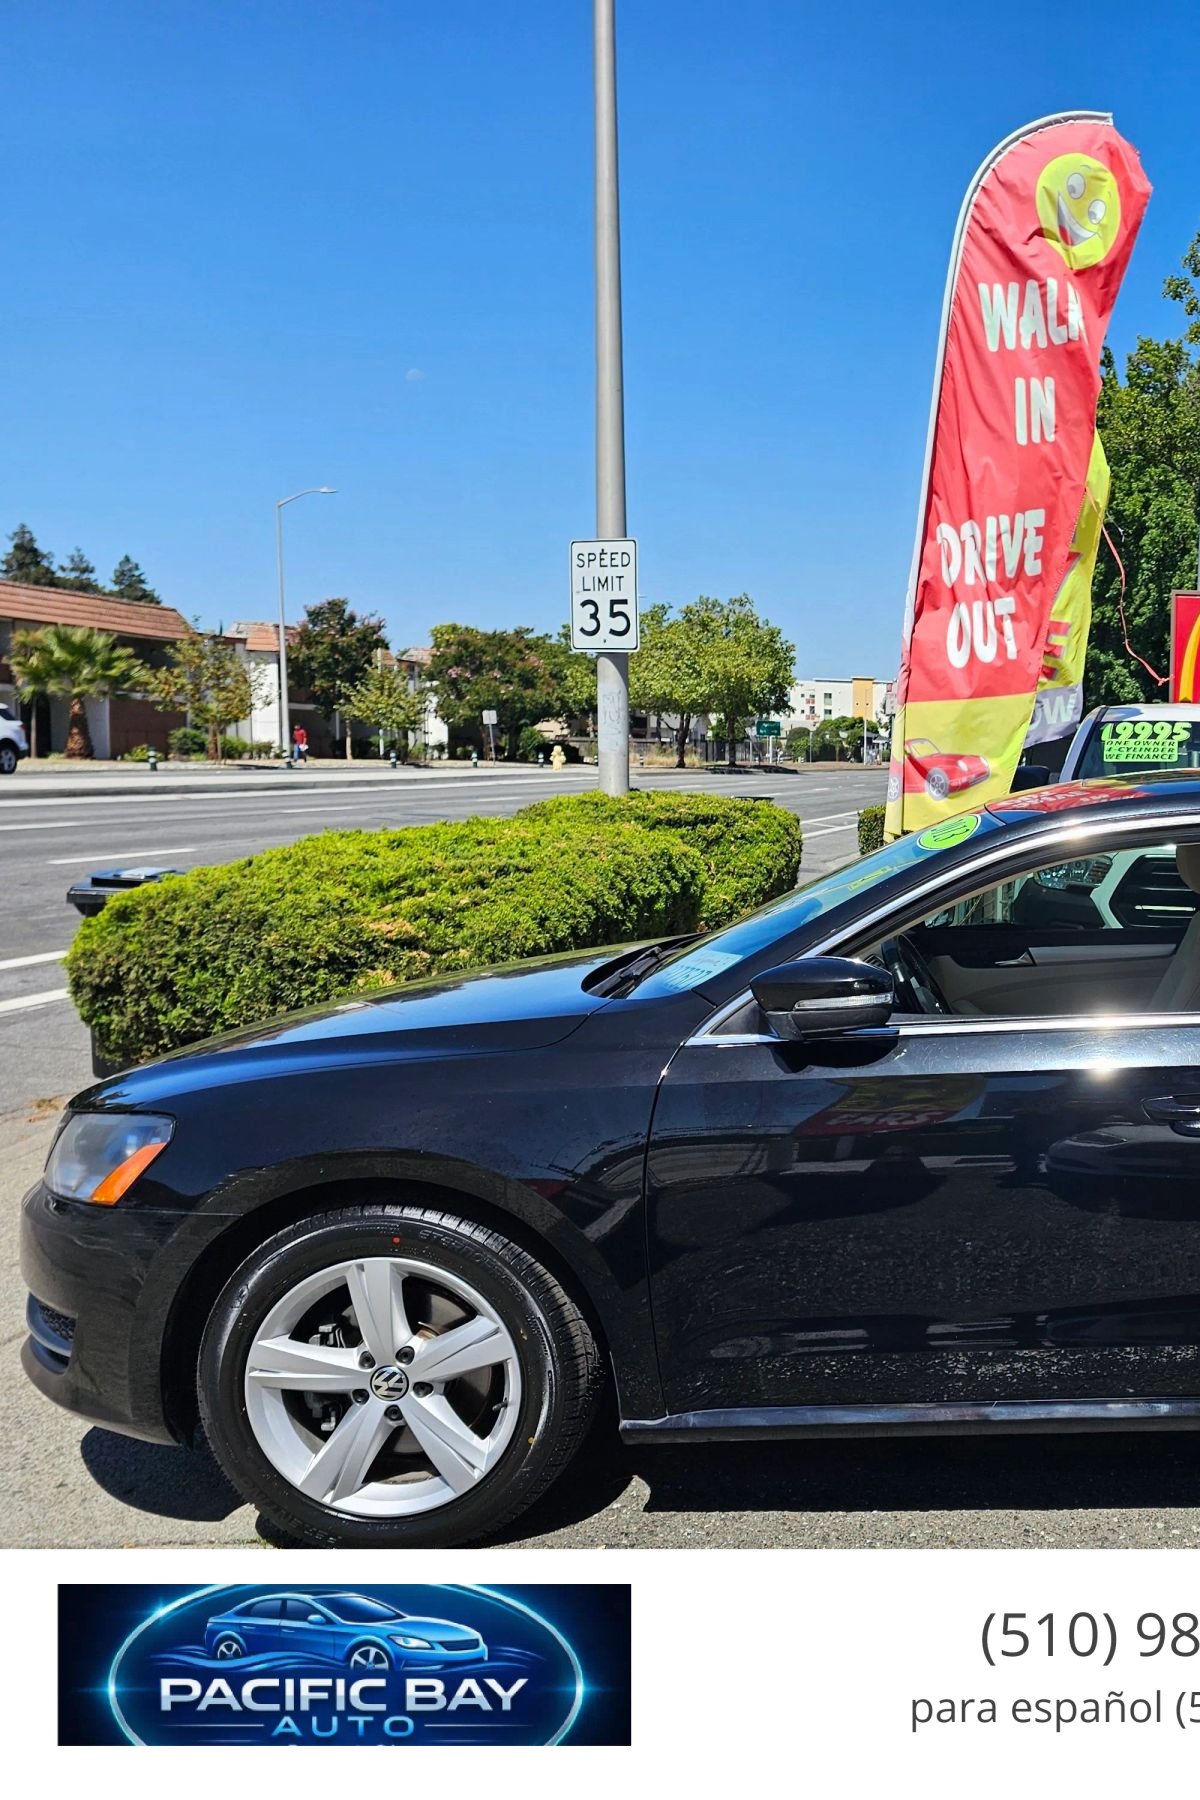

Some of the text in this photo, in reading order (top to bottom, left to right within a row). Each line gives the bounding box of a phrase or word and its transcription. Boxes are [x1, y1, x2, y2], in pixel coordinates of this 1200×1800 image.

[1015, 376, 1055, 446] IN
[576, 551, 631, 568] SPEED
[936, 509, 1045, 589] DRIVE
[582, 576, 624, 592] LIMIT
[579, 599, 631, 637] 35
[946, 597, 1018, 669] OUT
[1100, 721, 1192, 742] 19995
